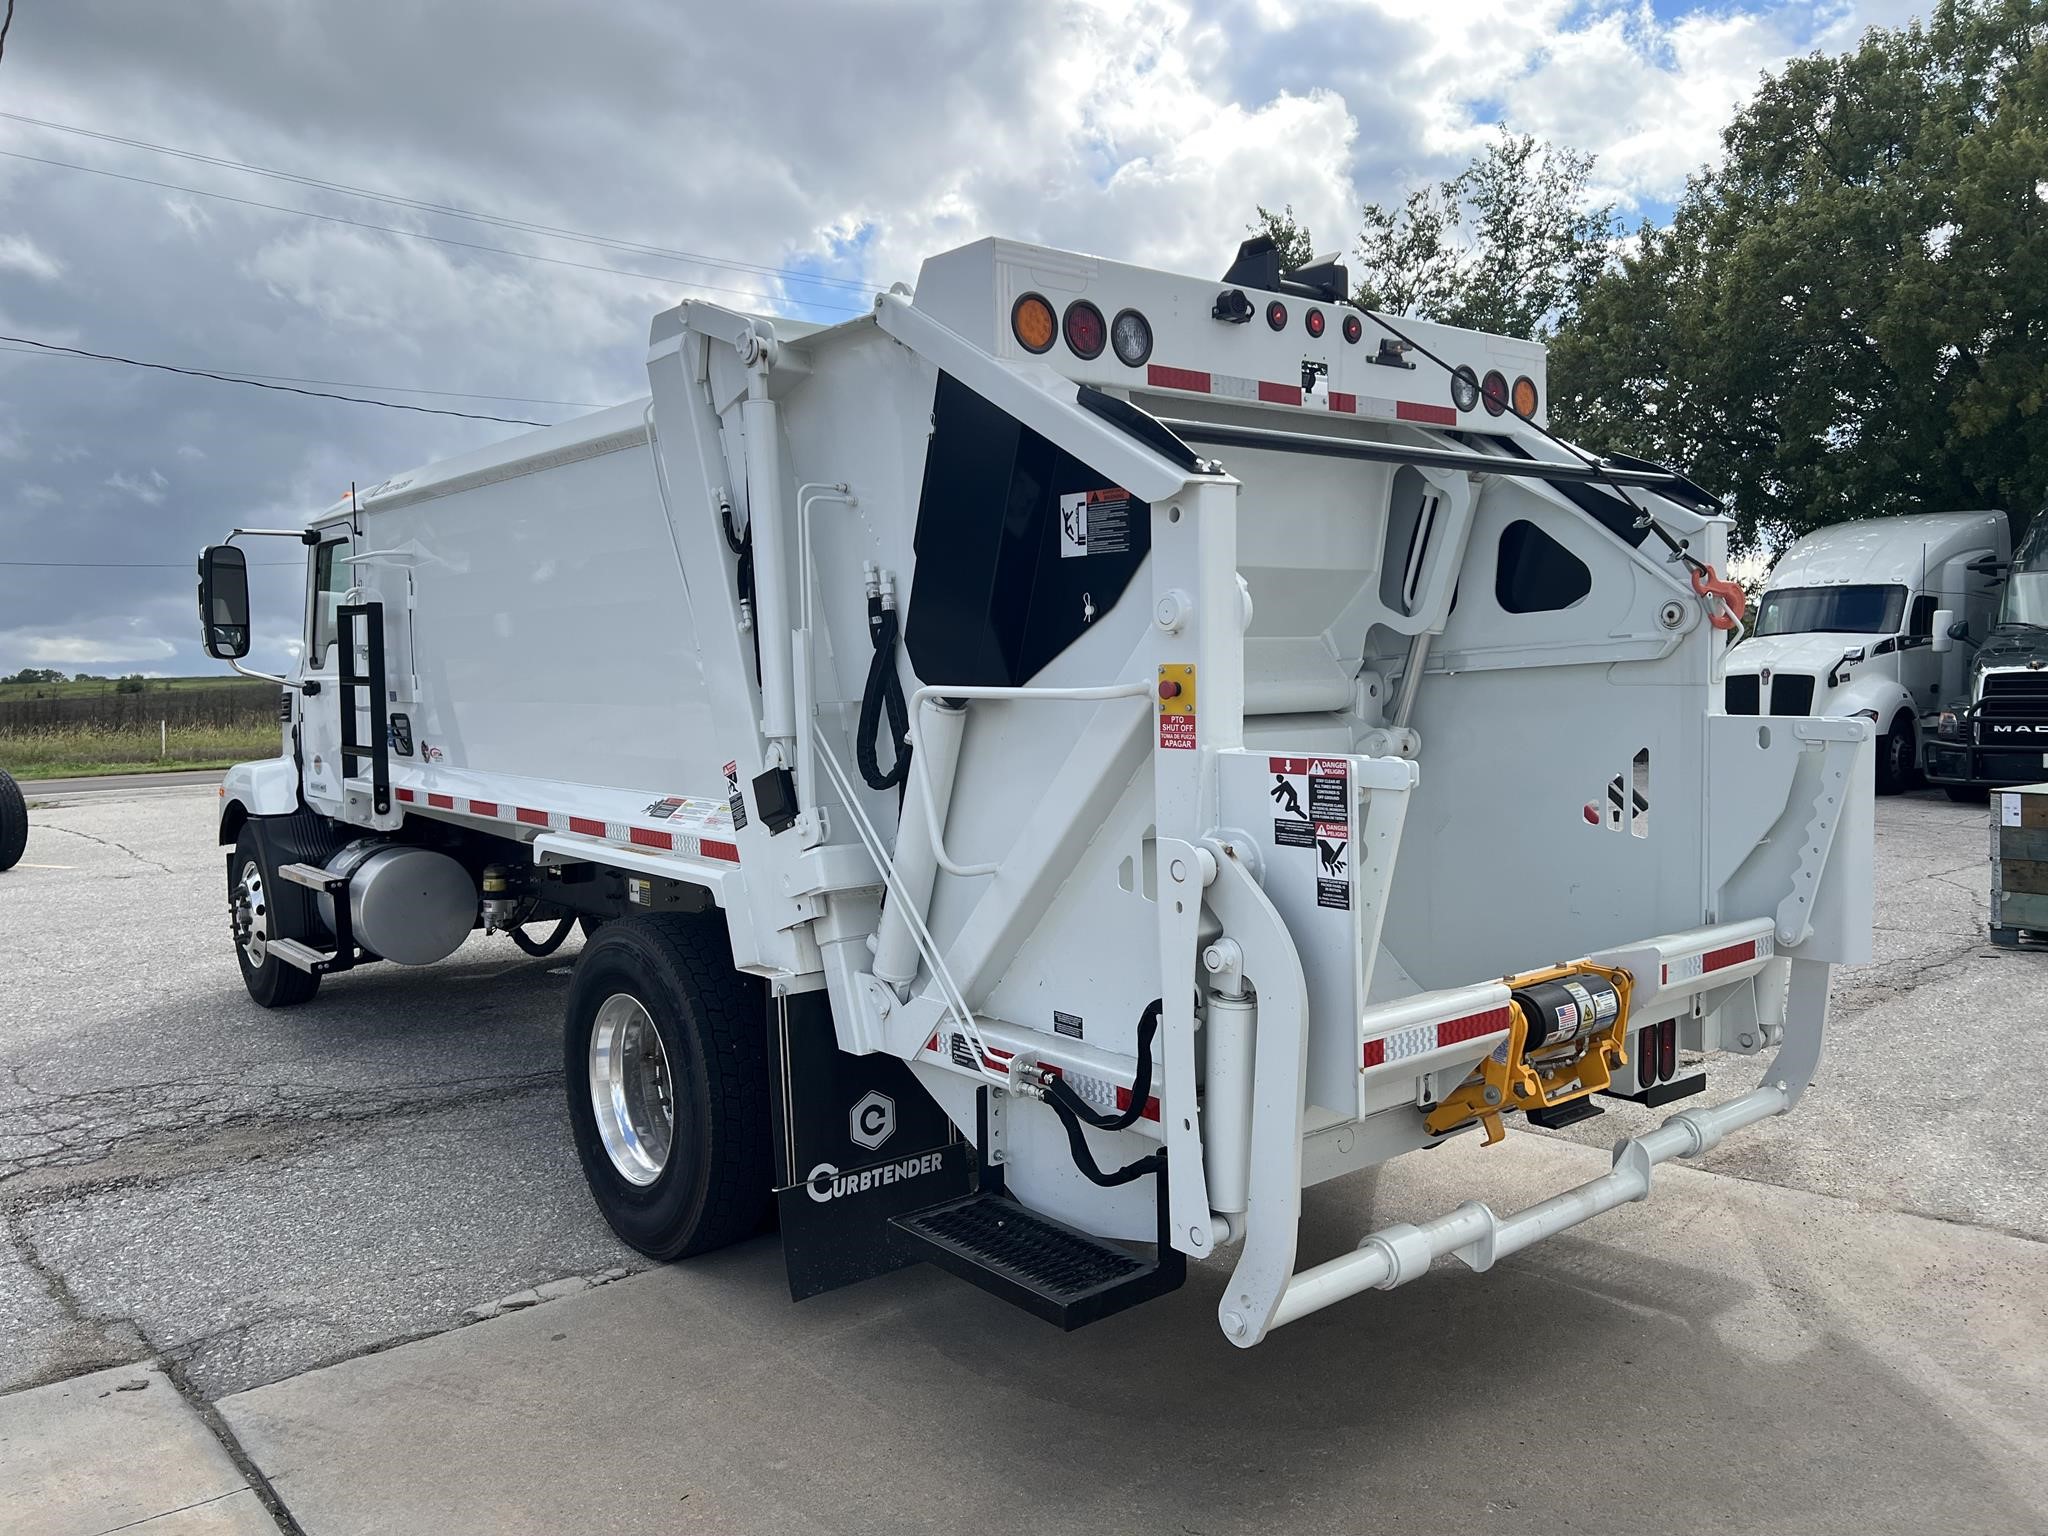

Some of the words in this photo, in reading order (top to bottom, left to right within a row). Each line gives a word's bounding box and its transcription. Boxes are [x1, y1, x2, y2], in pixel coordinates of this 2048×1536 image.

[1171, 716, 1184, 724] PTO
[1180, 724, 1194, 732] OFF
[1164, 740, 1192, 748] APAGAR
[1322, 761, 1347, 769] DANGER
[807, 1153, 942, 1203] CURBTENDER
